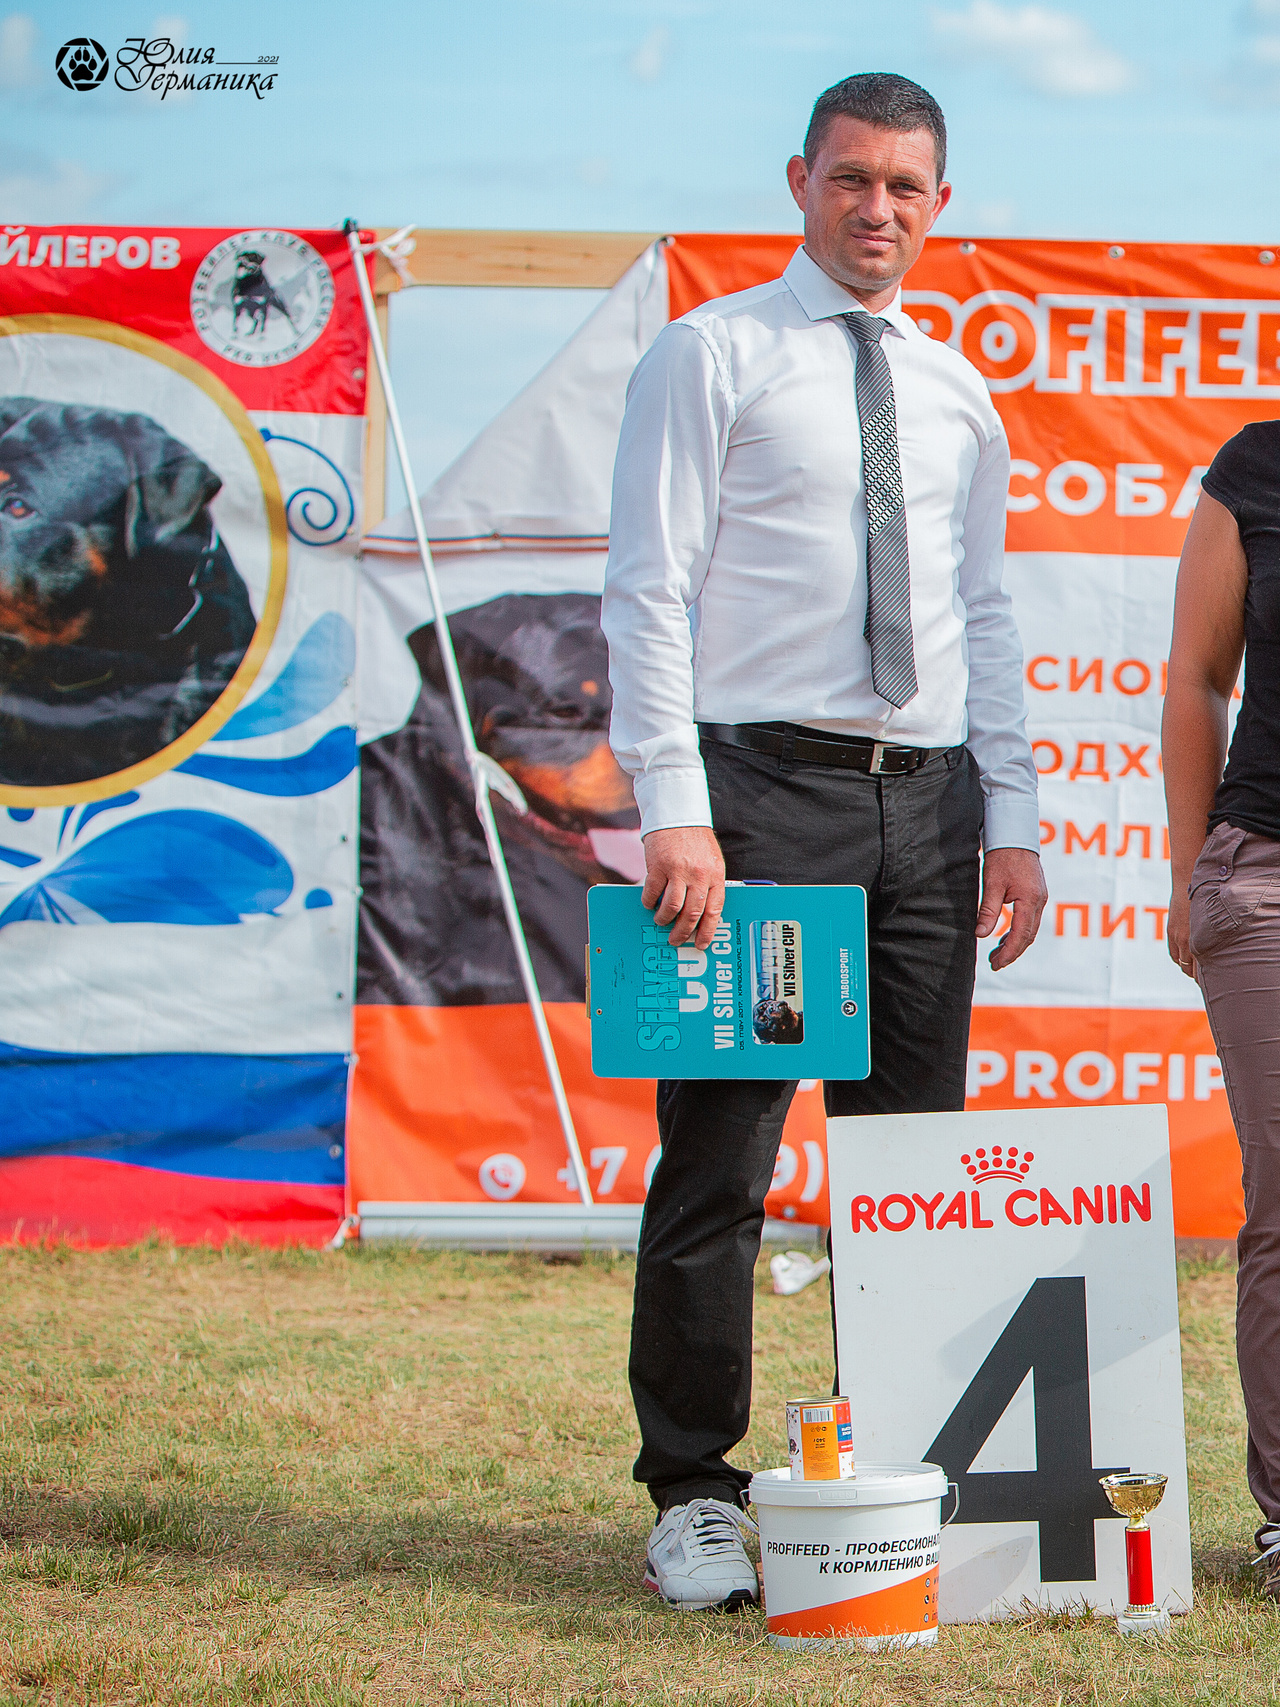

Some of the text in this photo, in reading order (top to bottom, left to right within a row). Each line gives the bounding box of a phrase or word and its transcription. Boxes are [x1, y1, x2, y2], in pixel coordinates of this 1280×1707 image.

[782, 923, 796, 998] VII Silver CUP
[839, 947, 850, 1000] TABOOSPORT
[712, 960, 734, 1019] Silver
[713, 1025, 735, 1050] VII
[851, 1182, 1152, 1233] ROYAL CANIN
[921, 1276, 1131, 1583] 4
[767, 1541, 830, 1556] PROFIFEED
[819, 1562, 830, 1574] К
[833, 1555, 924, 1574] КОРМЛЕНИЮ
